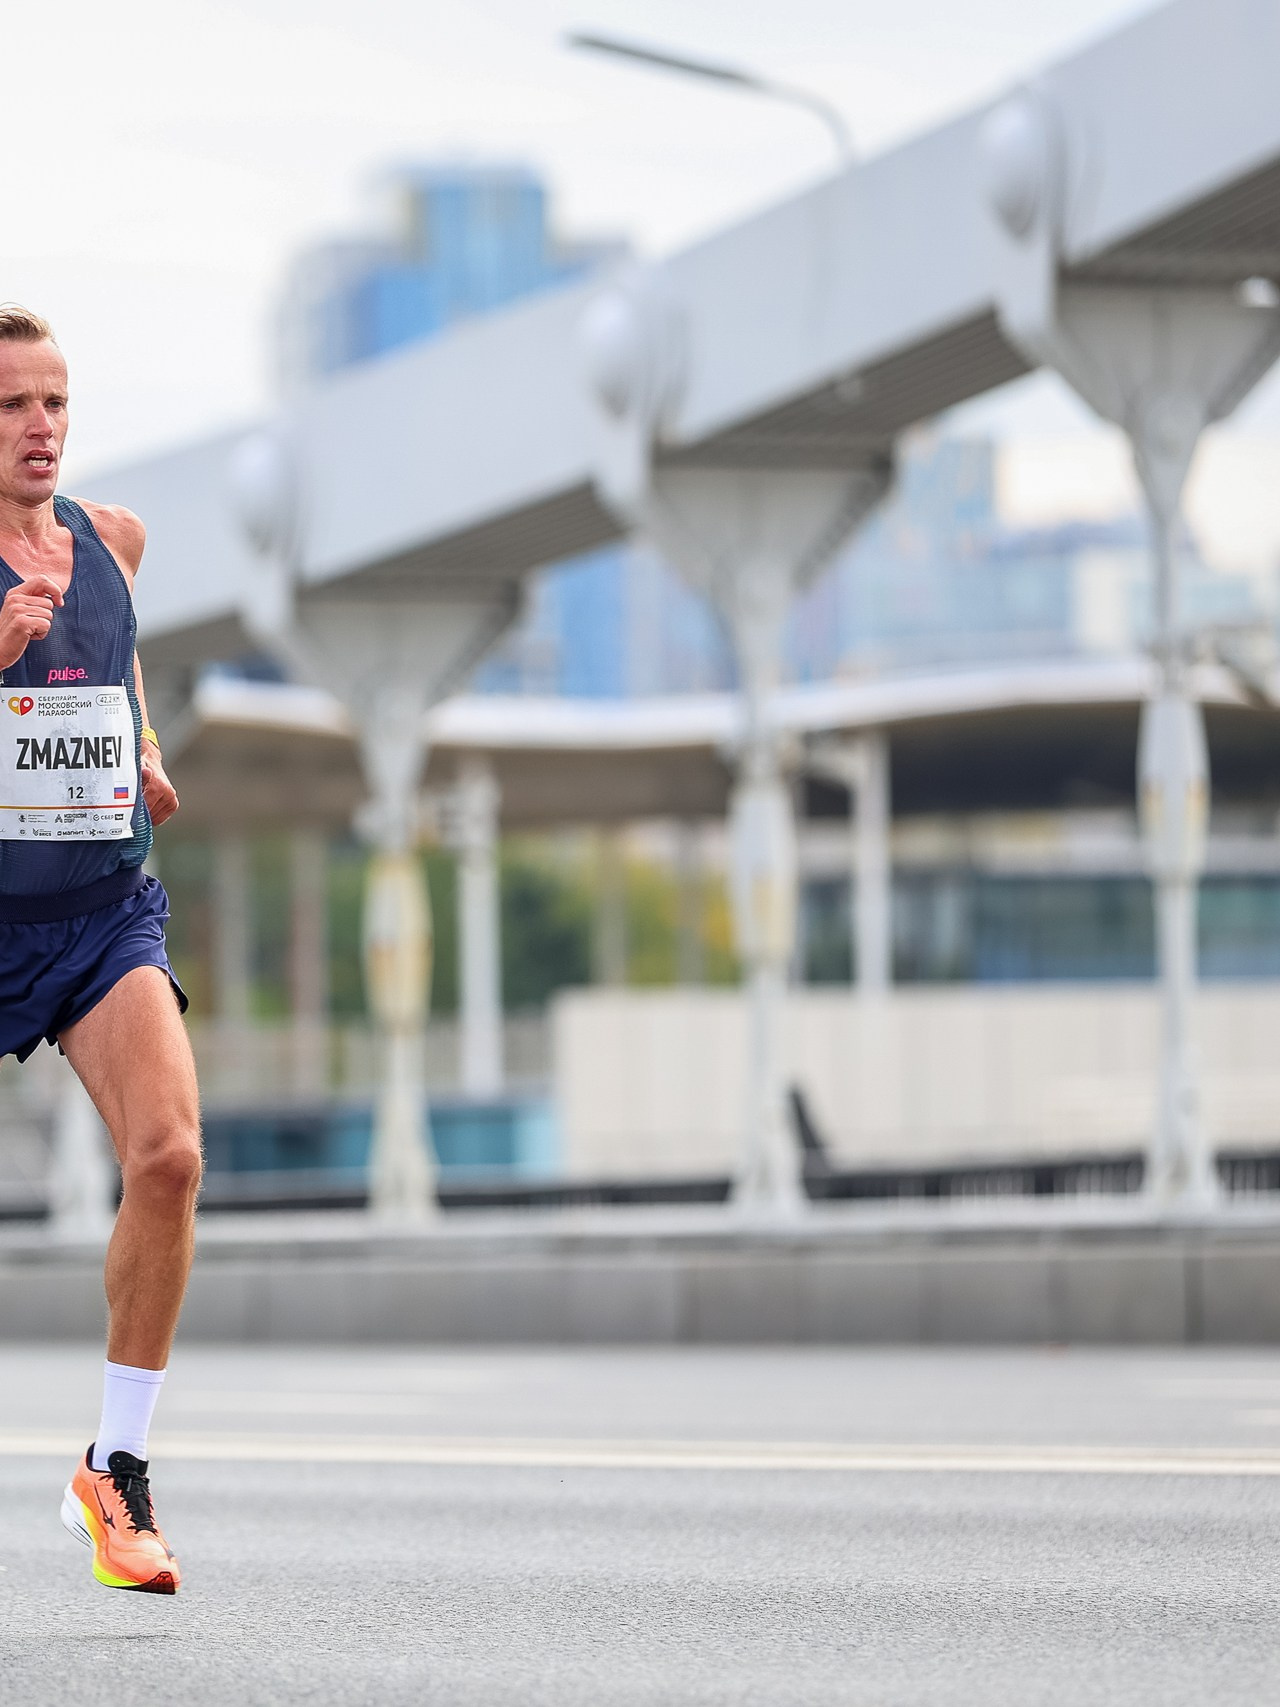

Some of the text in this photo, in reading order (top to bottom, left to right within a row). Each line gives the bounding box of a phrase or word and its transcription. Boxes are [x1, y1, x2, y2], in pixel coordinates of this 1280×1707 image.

[47, 666, 88, 684] pulse.
[38, 700, 92, 709] МОСКОВСКИЙ
[38, 709, 78, 717] МАРАФОН
[16, 736, 122, 770] ZMAZNEV
[67, 786, 85, 800] 12
